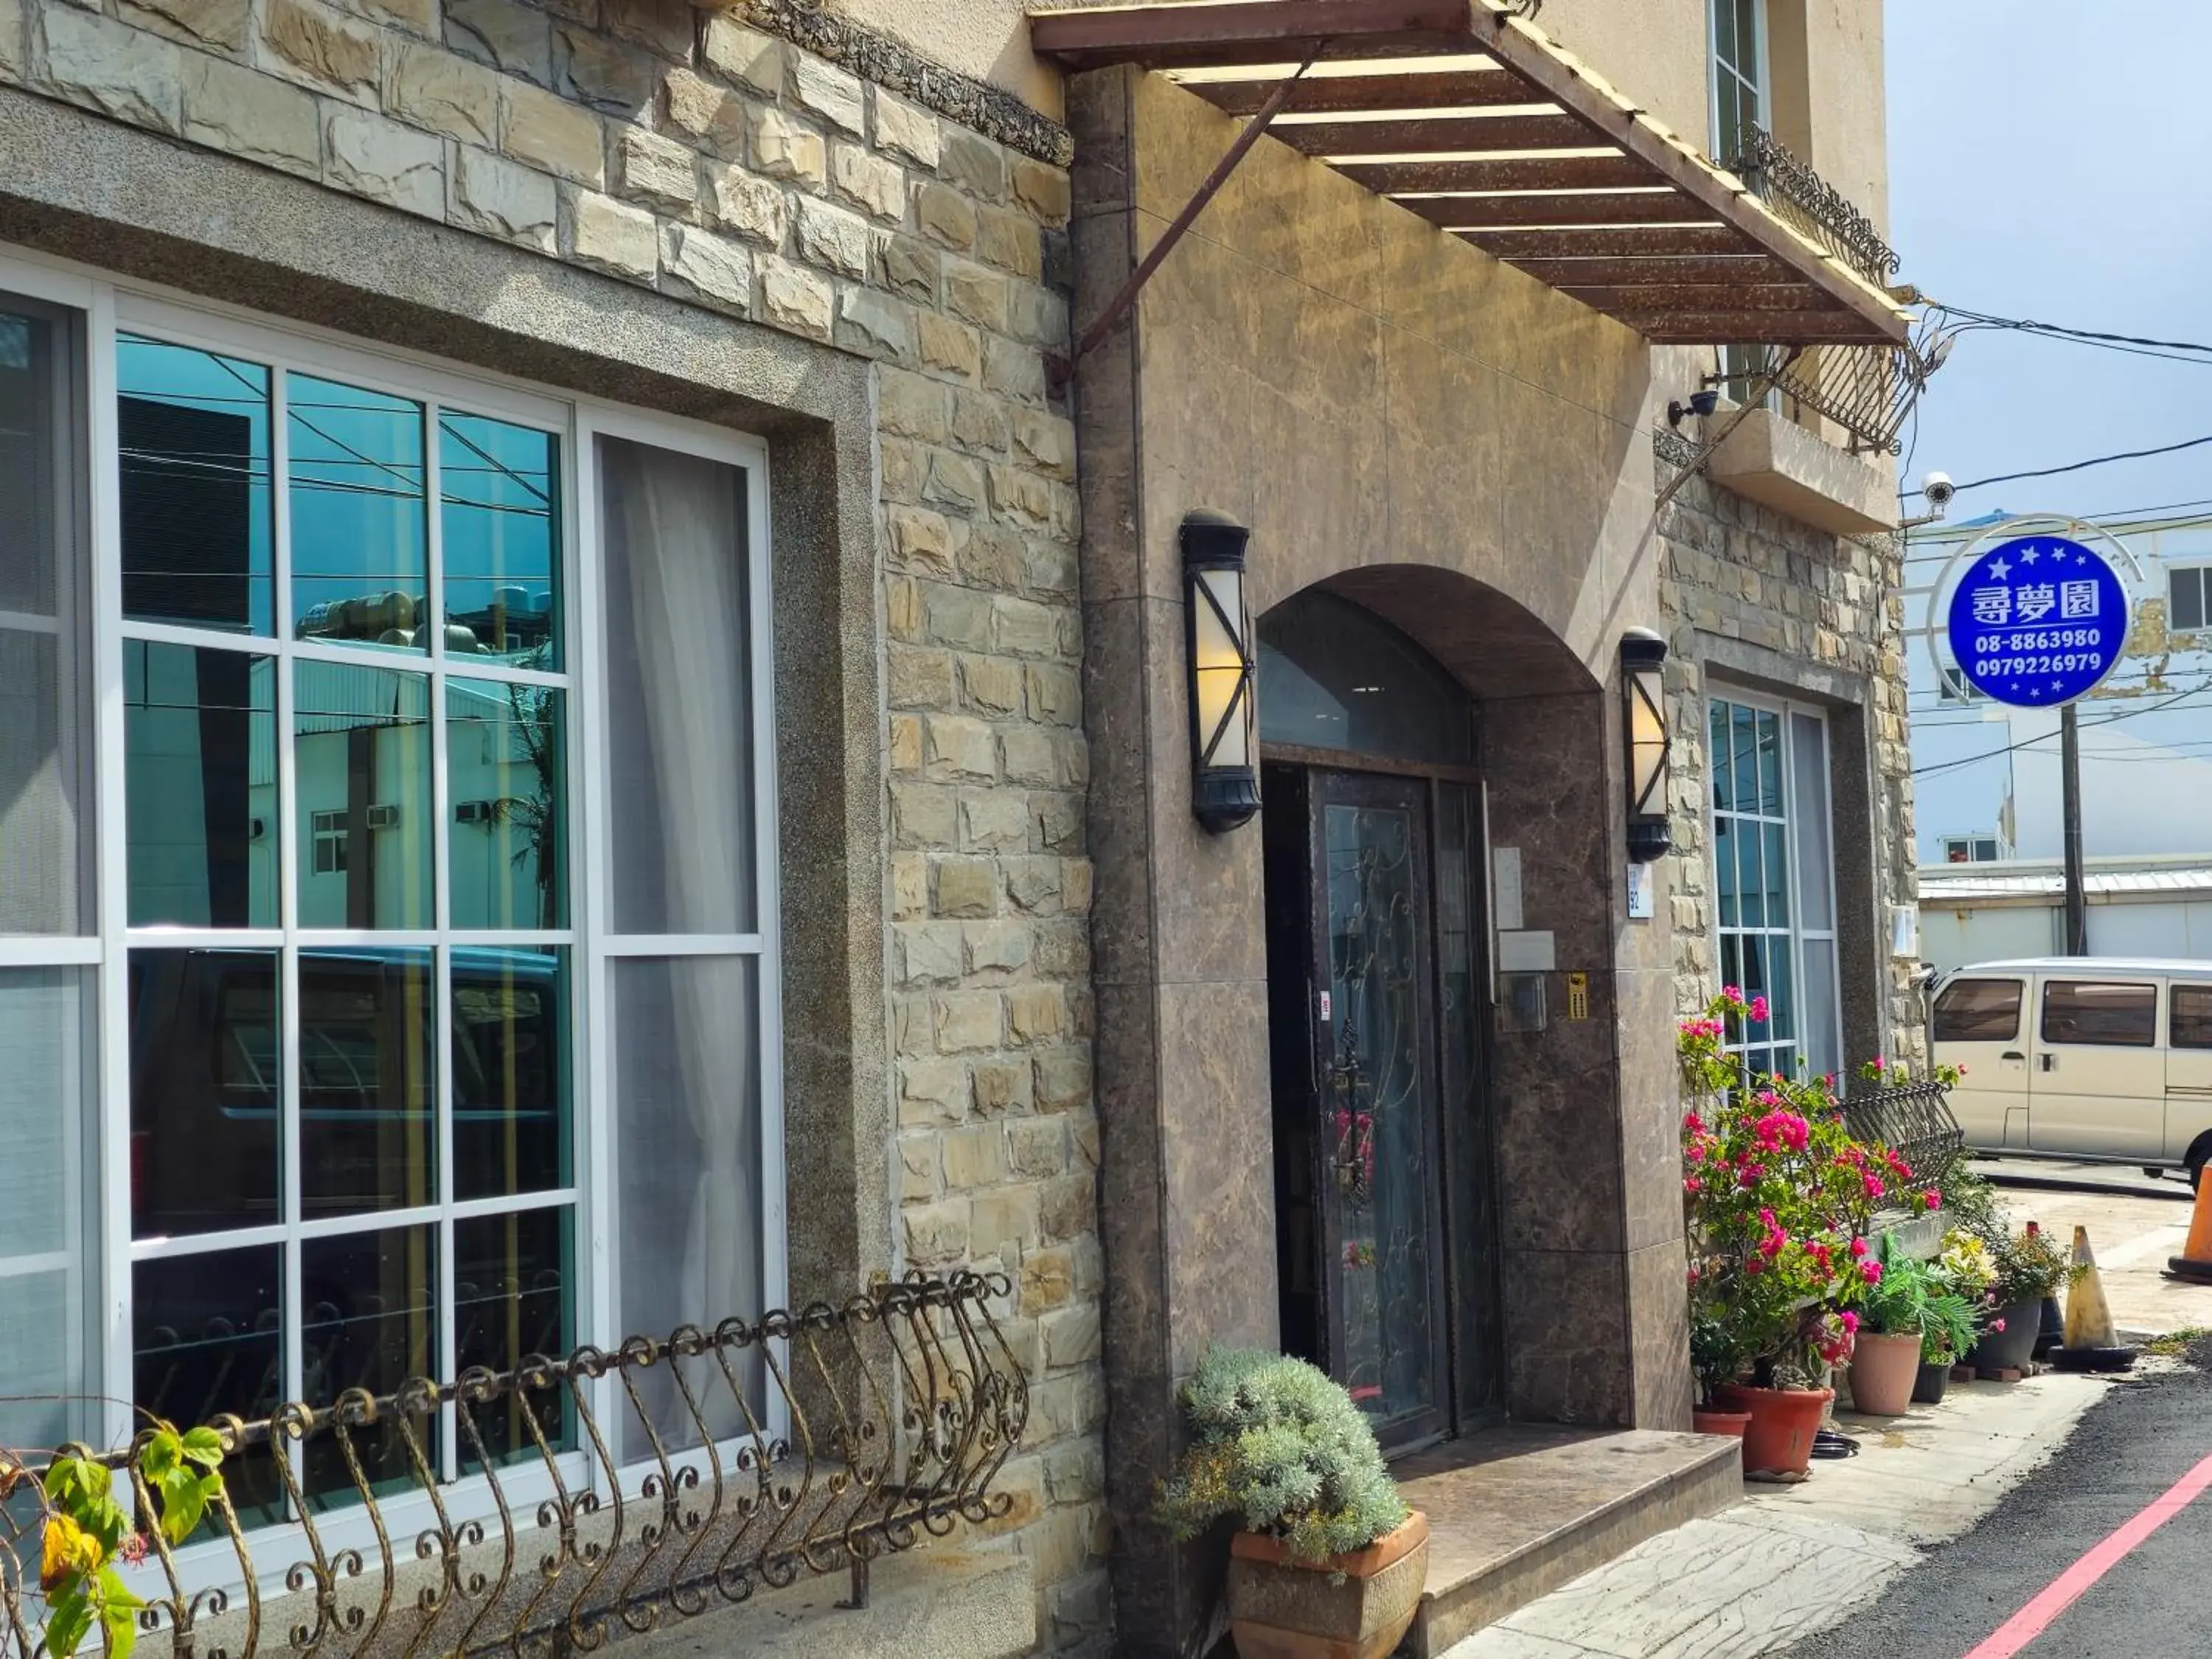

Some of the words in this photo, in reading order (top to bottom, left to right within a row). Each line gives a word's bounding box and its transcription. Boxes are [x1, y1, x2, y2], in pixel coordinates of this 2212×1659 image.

[1972, 580, 2099, 625] 尋夢園
[1975, 629, 2101, 653] 08-8863980
[1975, 653, 2101, 676] 0979226979
